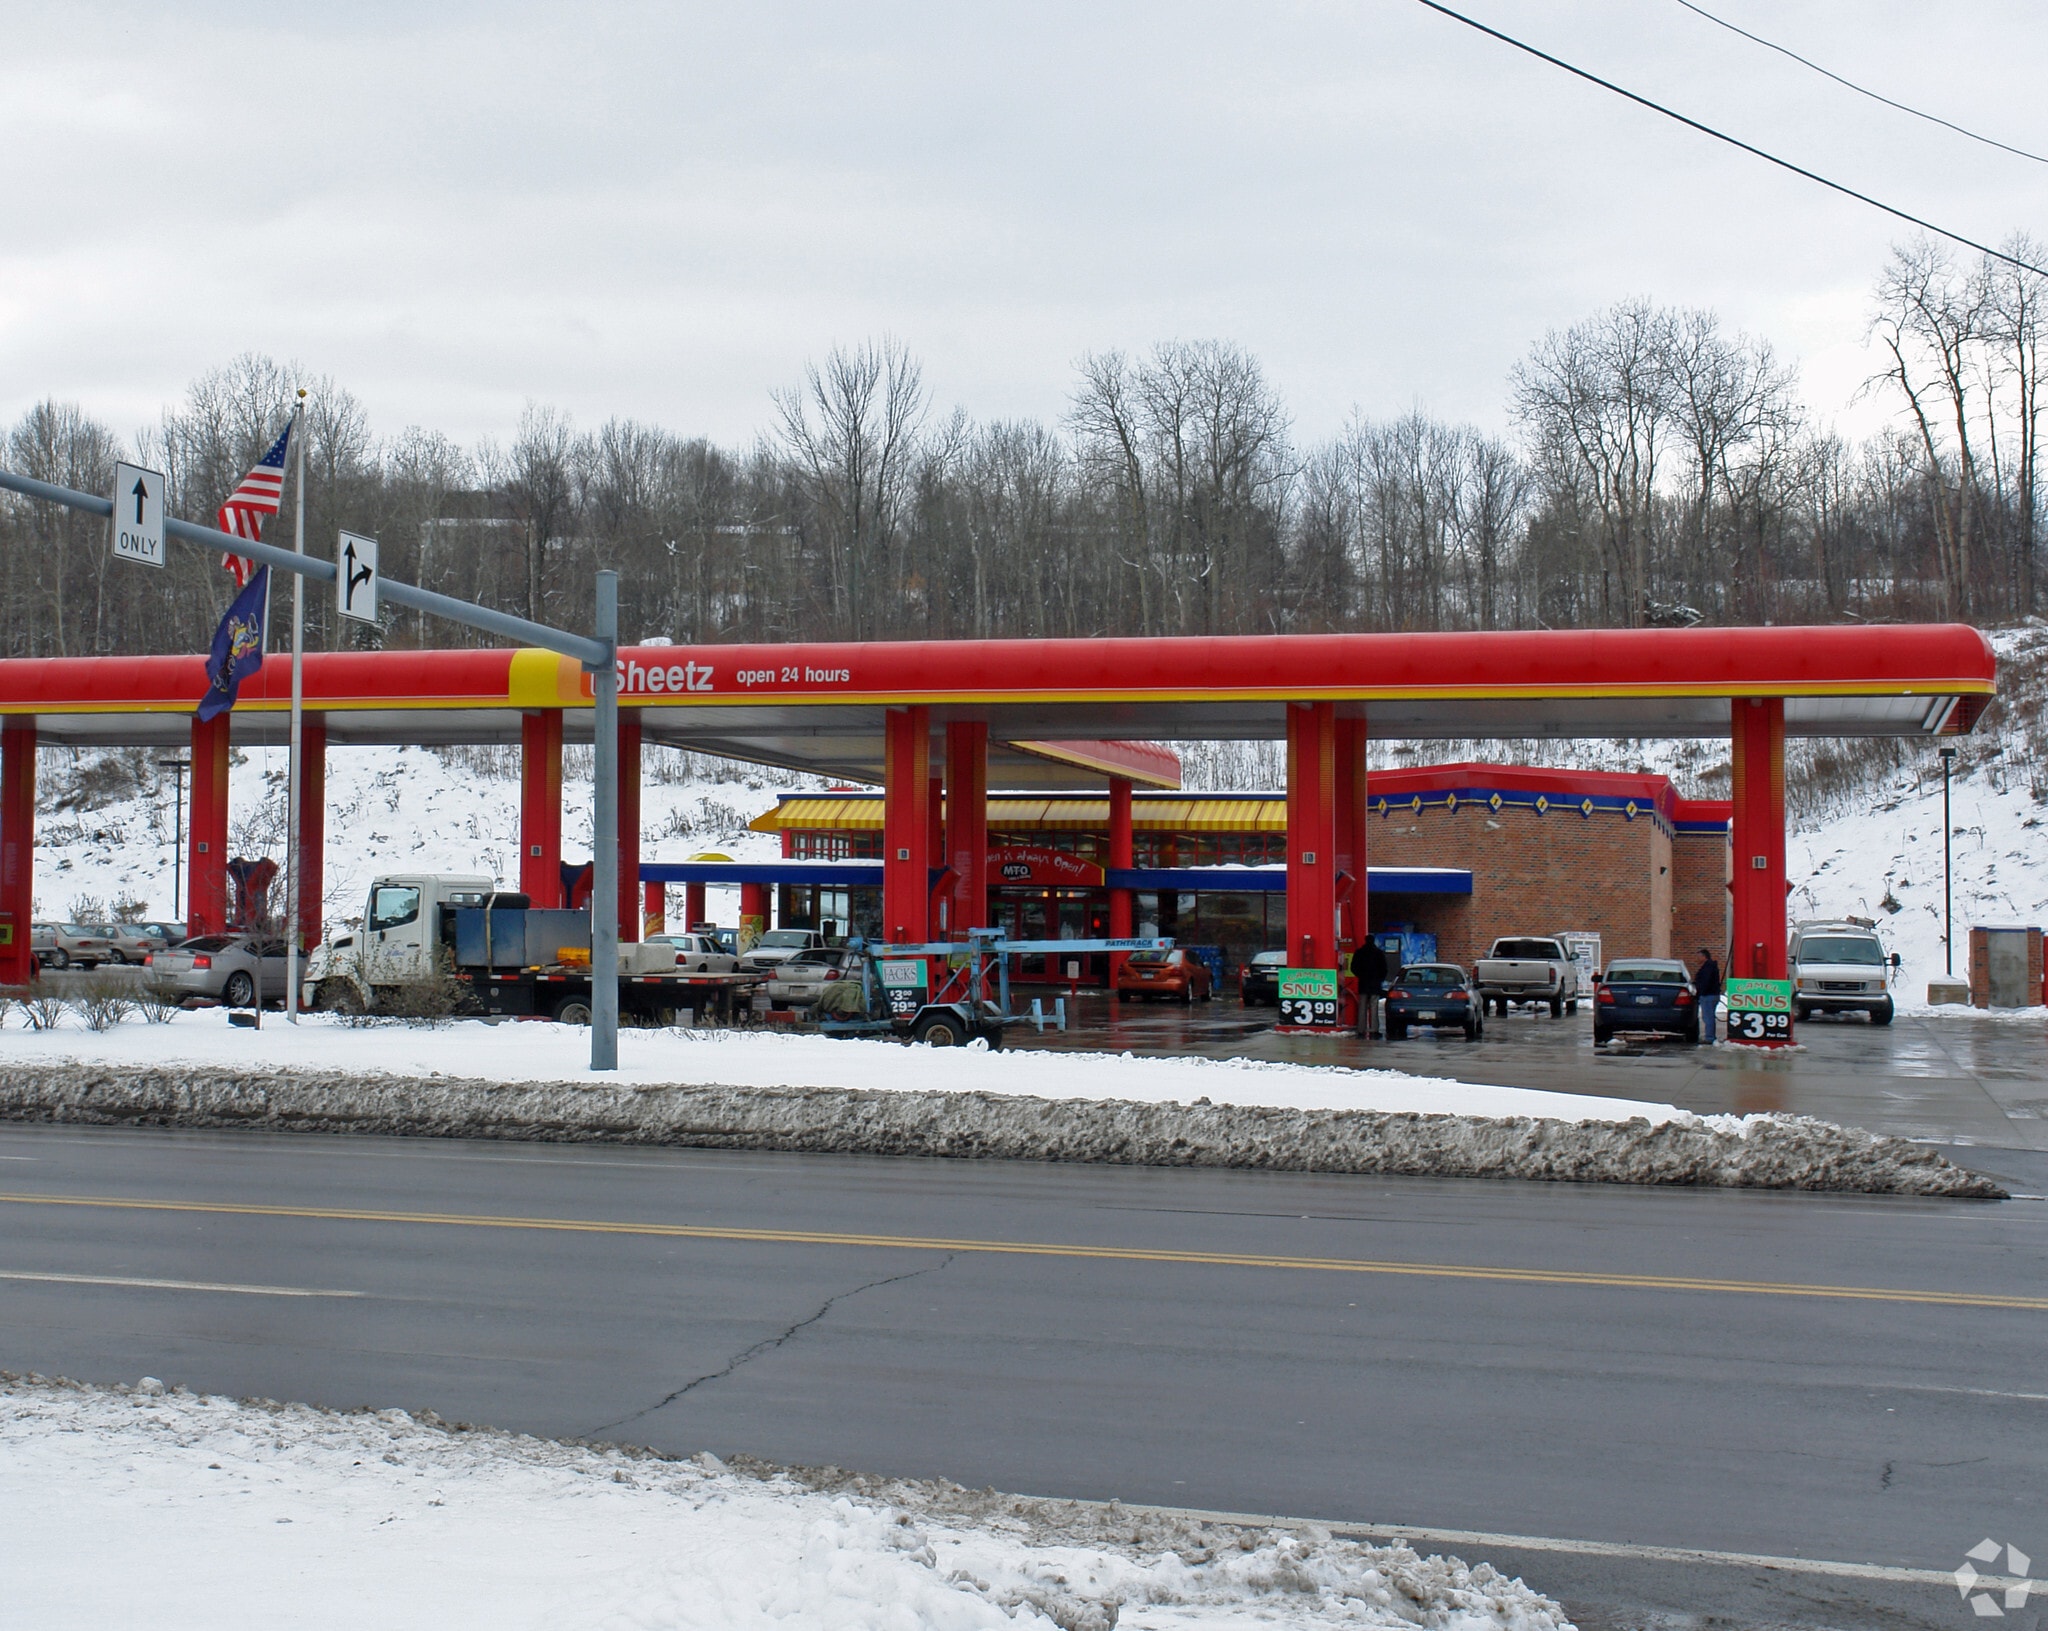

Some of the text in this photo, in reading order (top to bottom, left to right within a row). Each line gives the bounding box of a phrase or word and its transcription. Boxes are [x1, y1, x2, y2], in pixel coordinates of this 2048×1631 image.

[120, 532, 157, 556] ONLY
[737, 667, 850, 687] open 24 hours
[1003, 865, 1029, 875] MTO
[1287, 971, 1328, 982] CAMEL
[1282, 982, 1334, 997] SNUS
[1736, 982, 1781, 994] CAMEL
[1730, 994, 1788, 1009] SNUS
